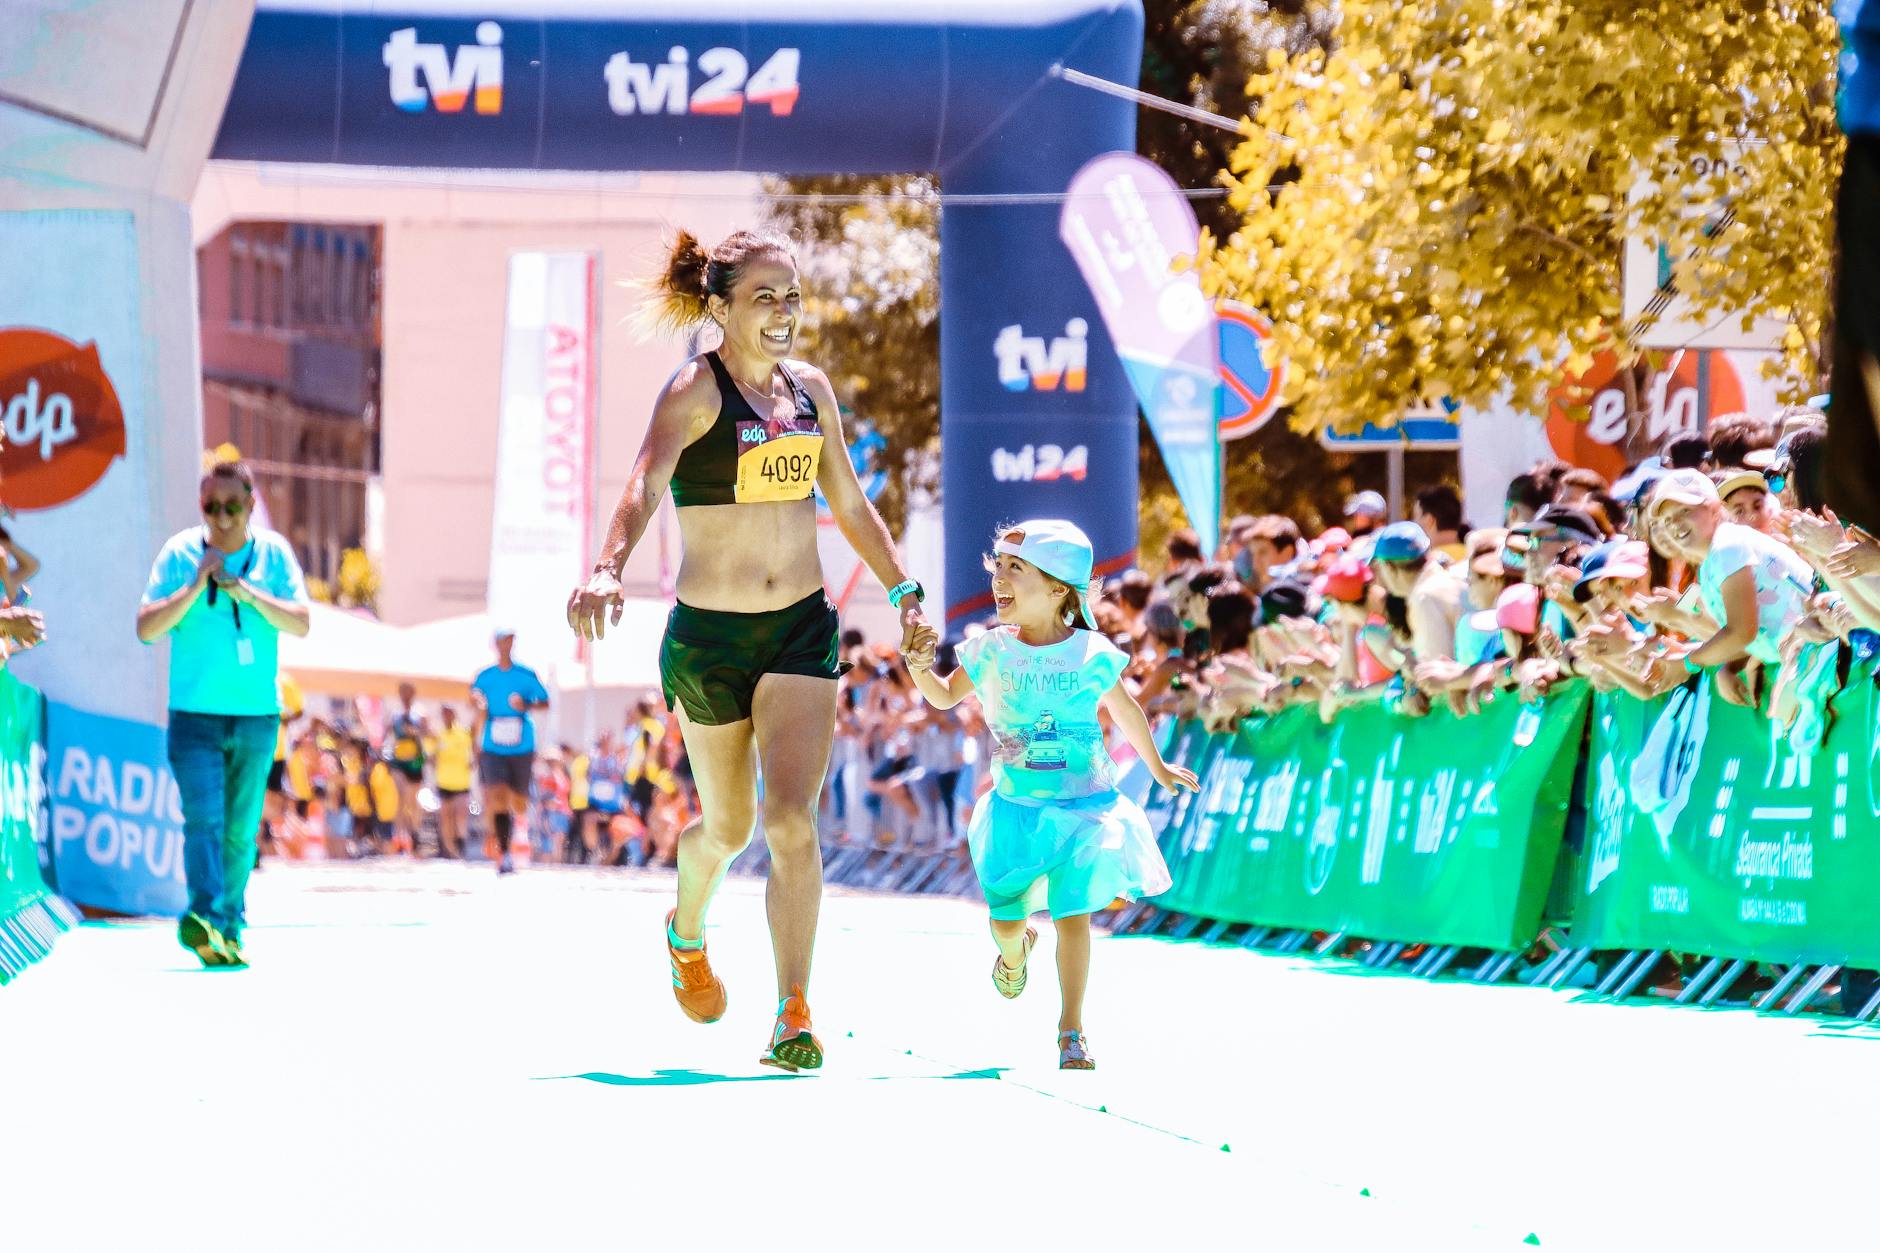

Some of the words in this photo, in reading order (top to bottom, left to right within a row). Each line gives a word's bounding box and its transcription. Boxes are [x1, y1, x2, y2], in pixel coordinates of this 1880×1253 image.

[383, 20, 503, 114] tvi
[993, 317, 1088, 391] tvi
[0, 377, 78, 462] dp
[741, 424, 767, 446] edp
[761, 454, 812, 483] 4092
[1028, 655, 1043, 664] THE
[1045, 656, 1066, 667] ROAD
[1000, 671, 1080, 692] SUMMER
